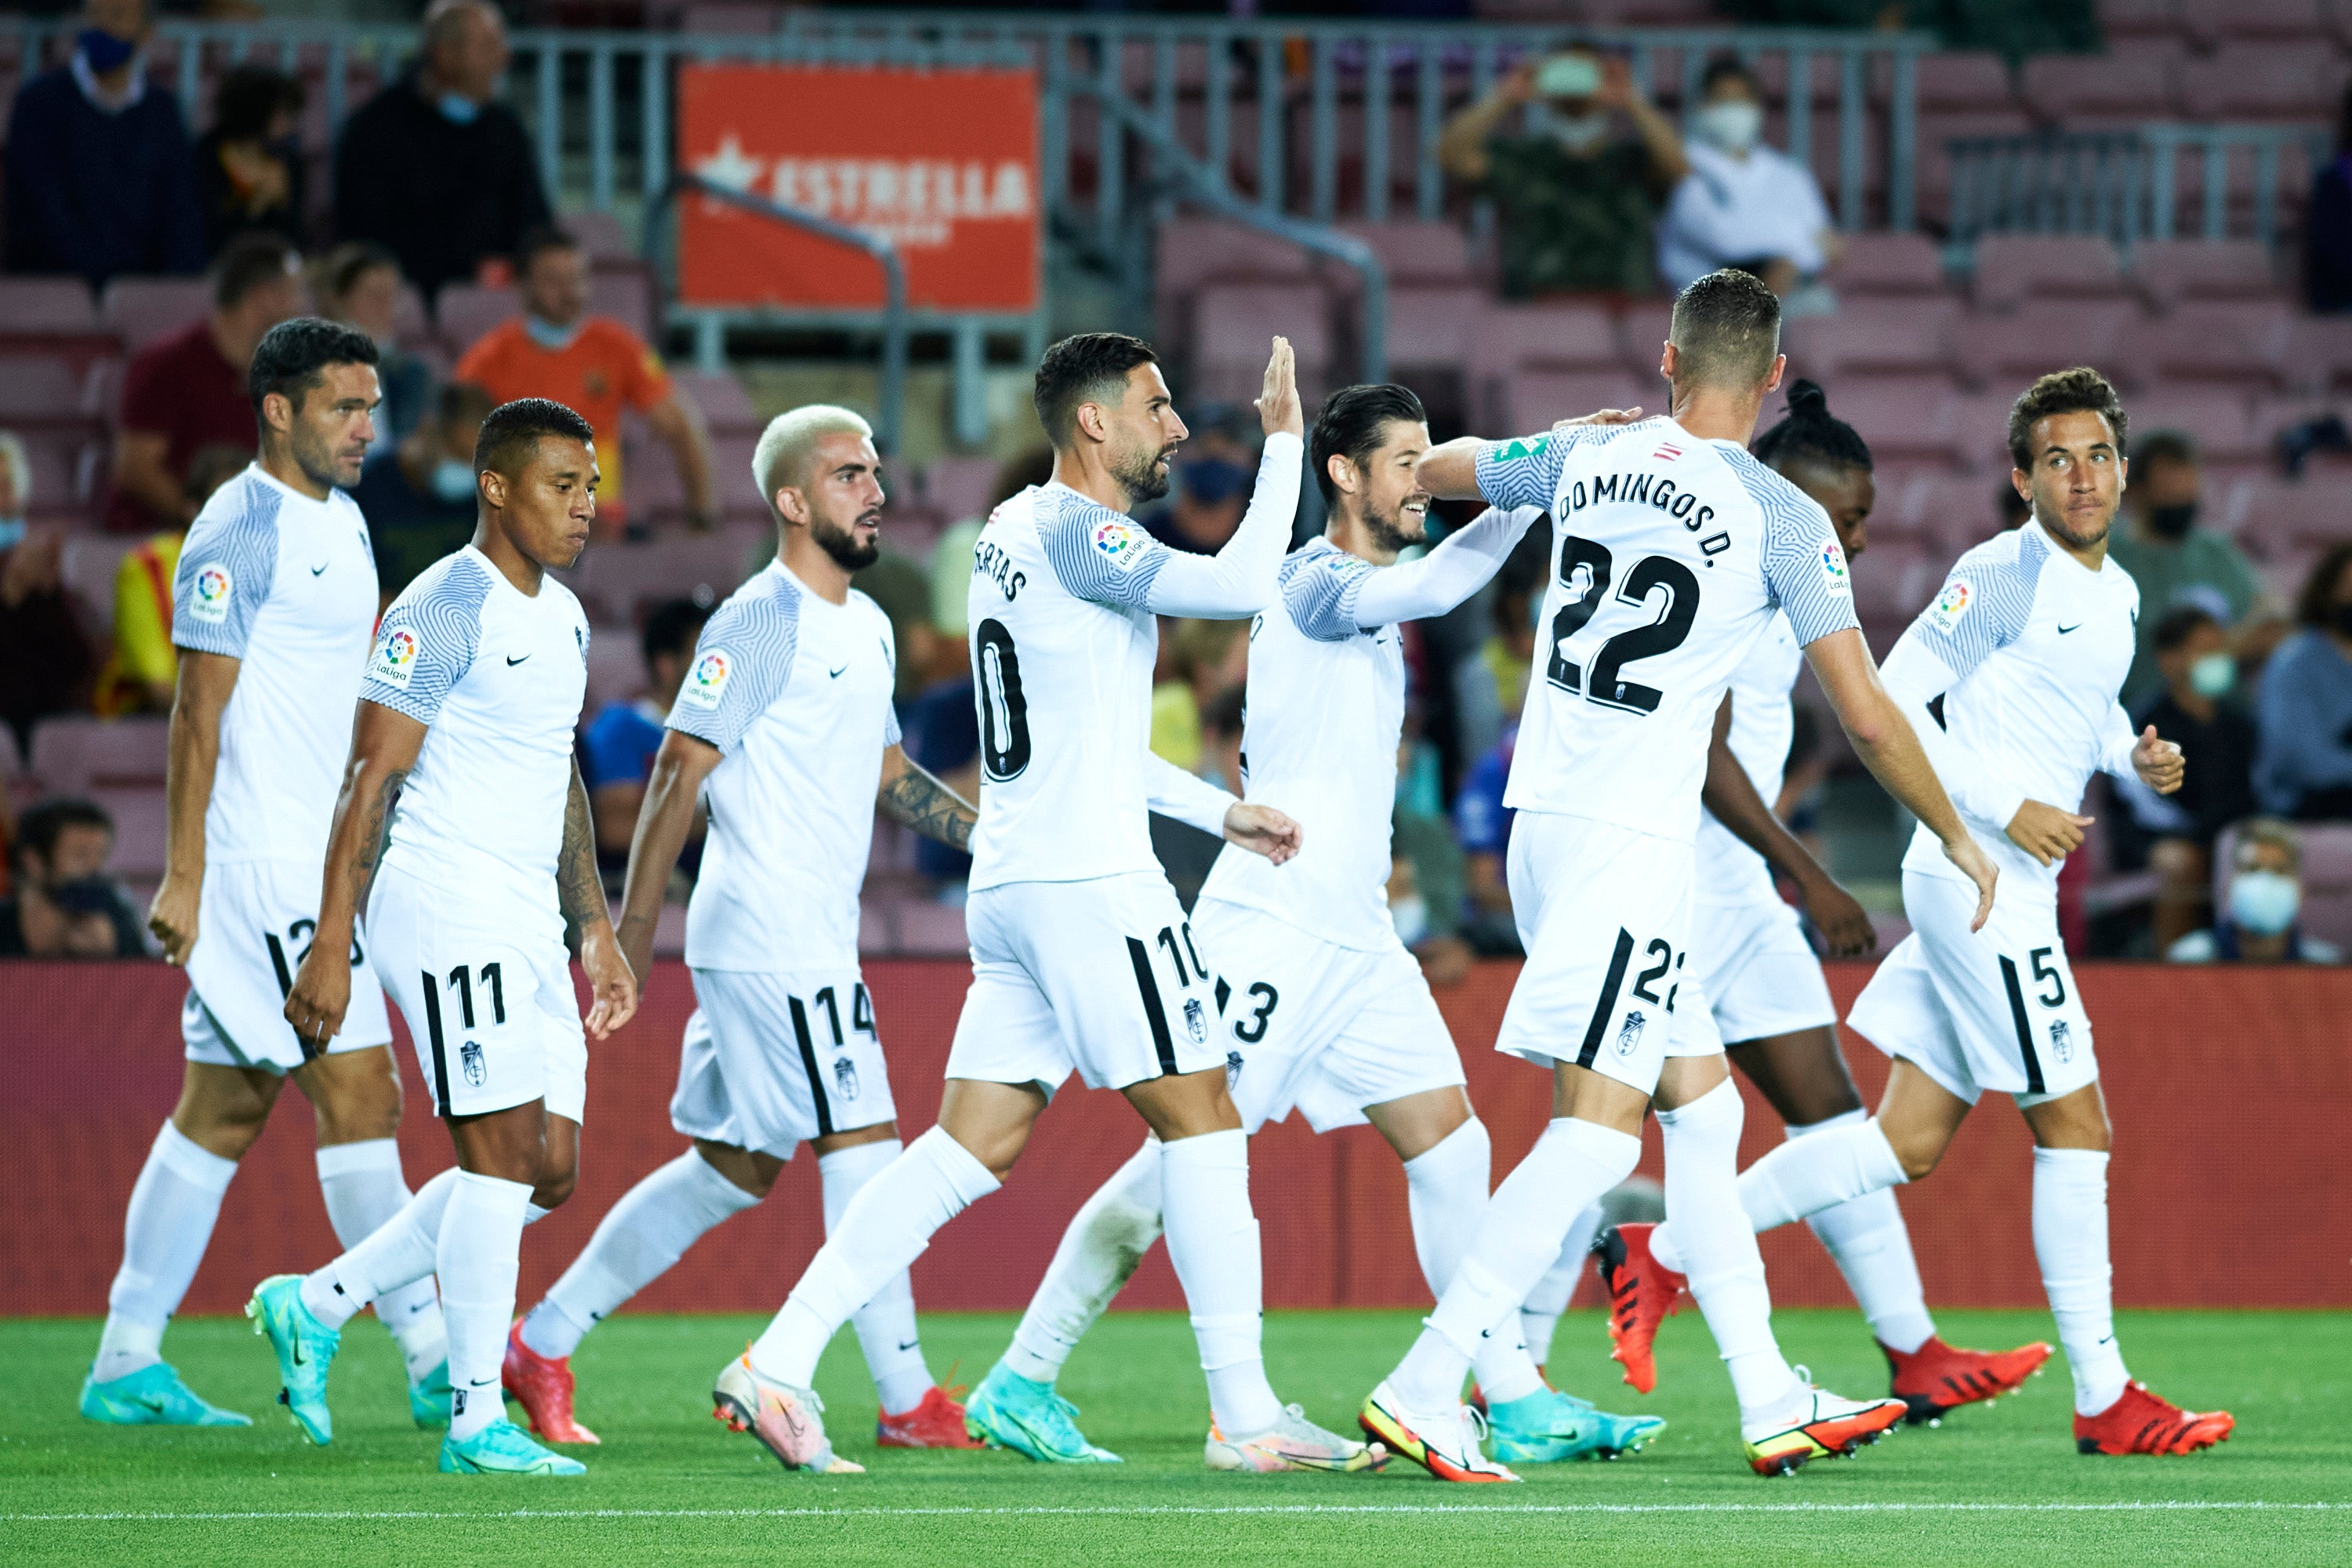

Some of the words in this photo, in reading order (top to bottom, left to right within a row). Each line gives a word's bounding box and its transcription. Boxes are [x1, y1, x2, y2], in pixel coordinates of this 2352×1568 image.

[771, 160, 1030, 220] ESTRELLA
[1119, 539, 1145, 565] LaLiga
[1560, 473, 1715, 532] DOMINGOS
[1697, 530, 1731, 568] D.
[975, 542, 1026, 602] ERTAS
[1547, 535, 1700, 717] 22
[376, 663, 407, 681] LaLiga
[688, 687, 717, 702] LaLiga
[1155, 921, 1210, 990] 10
[2027, 946, 2066, 1010] 5
[446, 962, 506, 1031] 11
[813, 982, 878, 1051] 14
[1231, 982, 1279, 1045] 3
